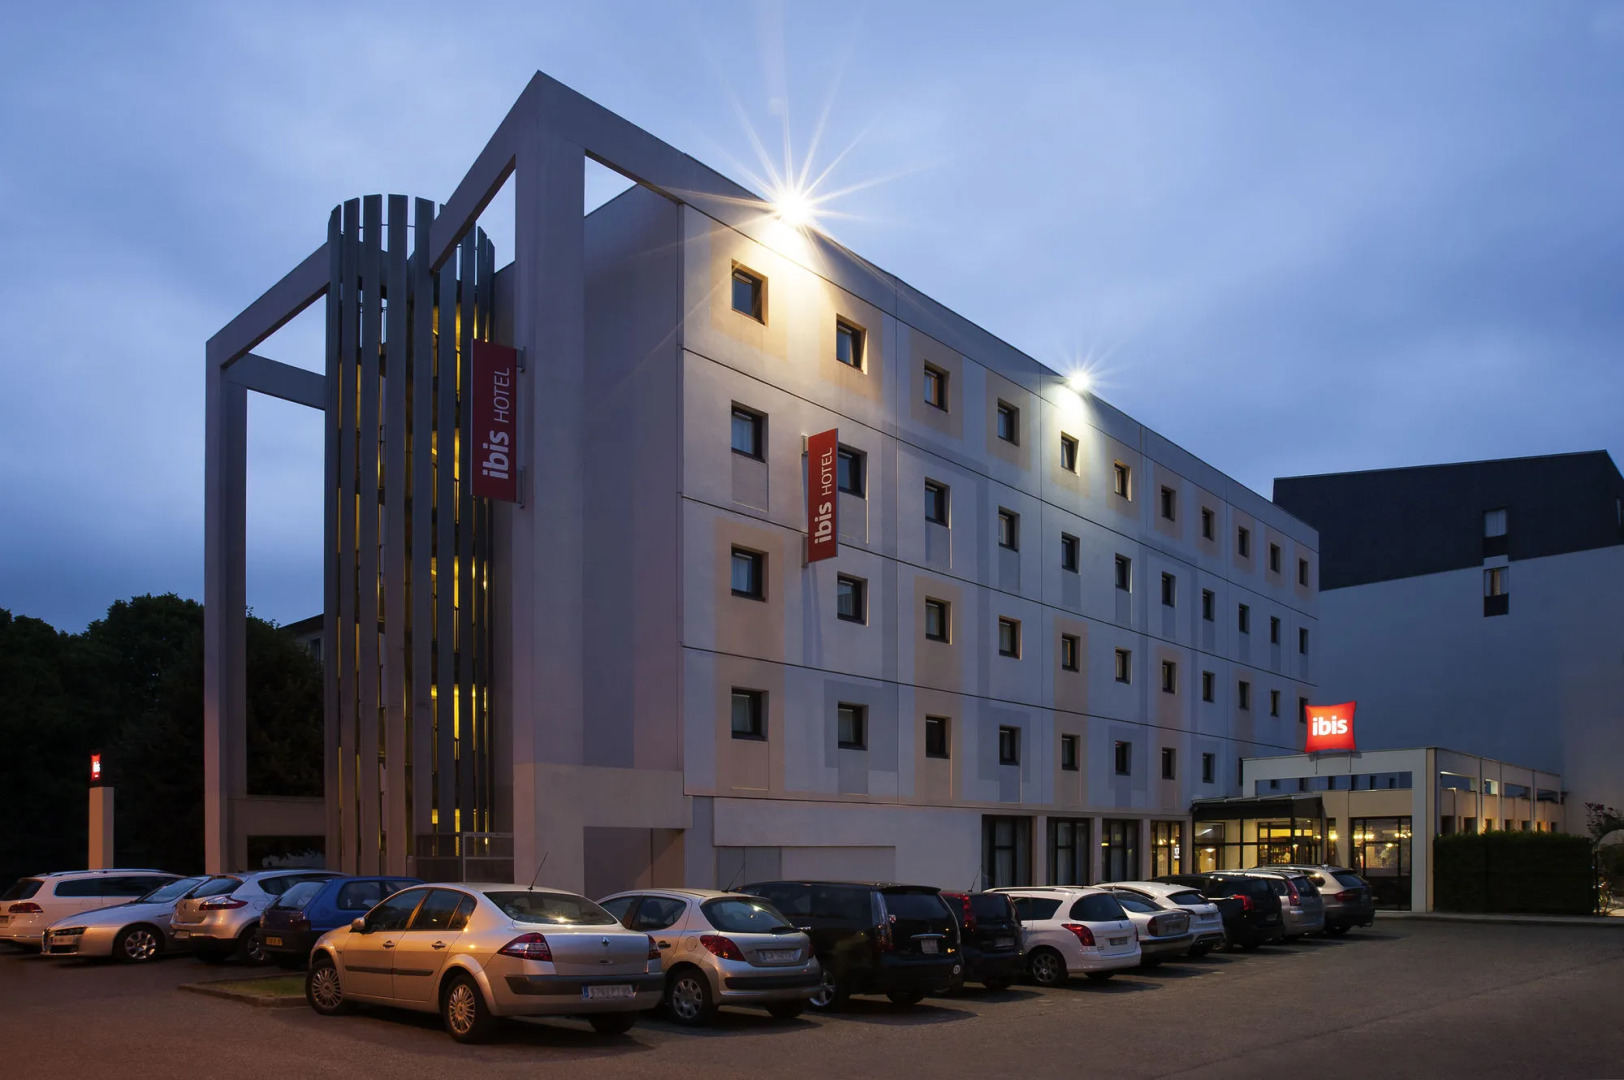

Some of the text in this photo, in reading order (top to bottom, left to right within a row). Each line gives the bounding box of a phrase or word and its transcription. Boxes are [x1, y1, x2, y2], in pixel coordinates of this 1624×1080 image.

[483, 367, 510, 479] ibis HOTEL
[815, 447, 832, 544] ibis HOTEL
[1312, 715, 1348, 736] ibis
